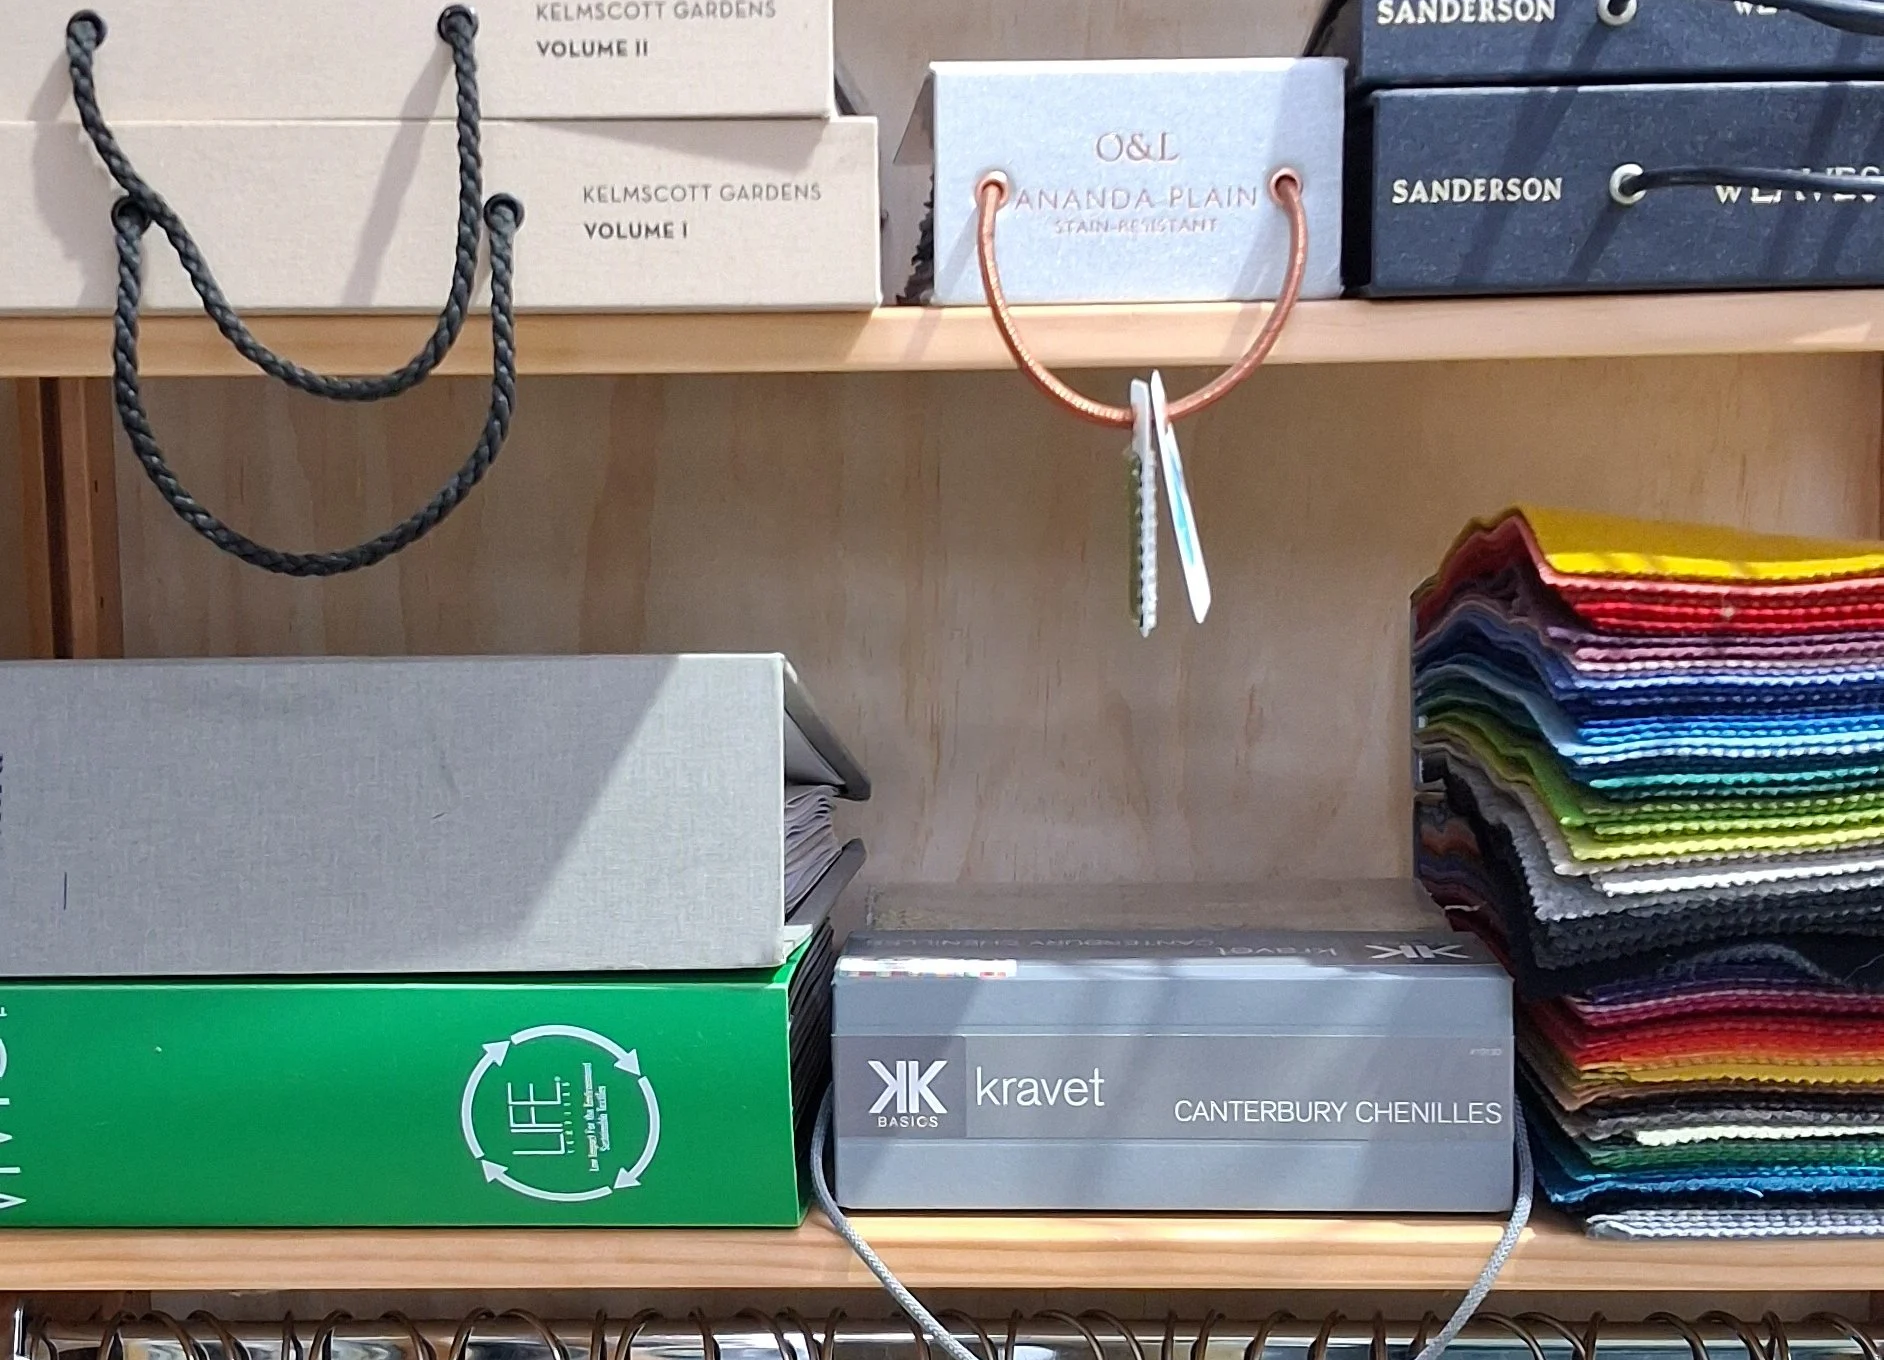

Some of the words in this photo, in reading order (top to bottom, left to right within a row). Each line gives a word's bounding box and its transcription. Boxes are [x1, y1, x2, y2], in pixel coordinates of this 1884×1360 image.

[536, 0, 666, 22] KELMSCOTT
[673, 0, 777, 20] GARDENS
[536, 40, 629, 58] VOLUME
[635, 39, 649, 57] II
[1096, 131, 1179, 162] O&L
[583, 183, 712, 204] KELMSCOTT
[719, 182, 822, 202] GARDENS
[1014, 187, 1153, 211] ANANDA
[1168, 185, 1258, 209] PLAIN
[1392, 176, 1563, 205] SANDERSON
[584, 222, 674, 240] VOLUME
[682, 222, 688, 239] I
[1054, 217, 1219, 235] STAIN-RESISTANT
[976, 1067, 1105, 1107] kravet
[877, 1115, 939, 1128] BASICS
[1174, 1100, 1347, 1124] CANTERBURY
[1354, 1100, 1503, 1126] CHENILLES
